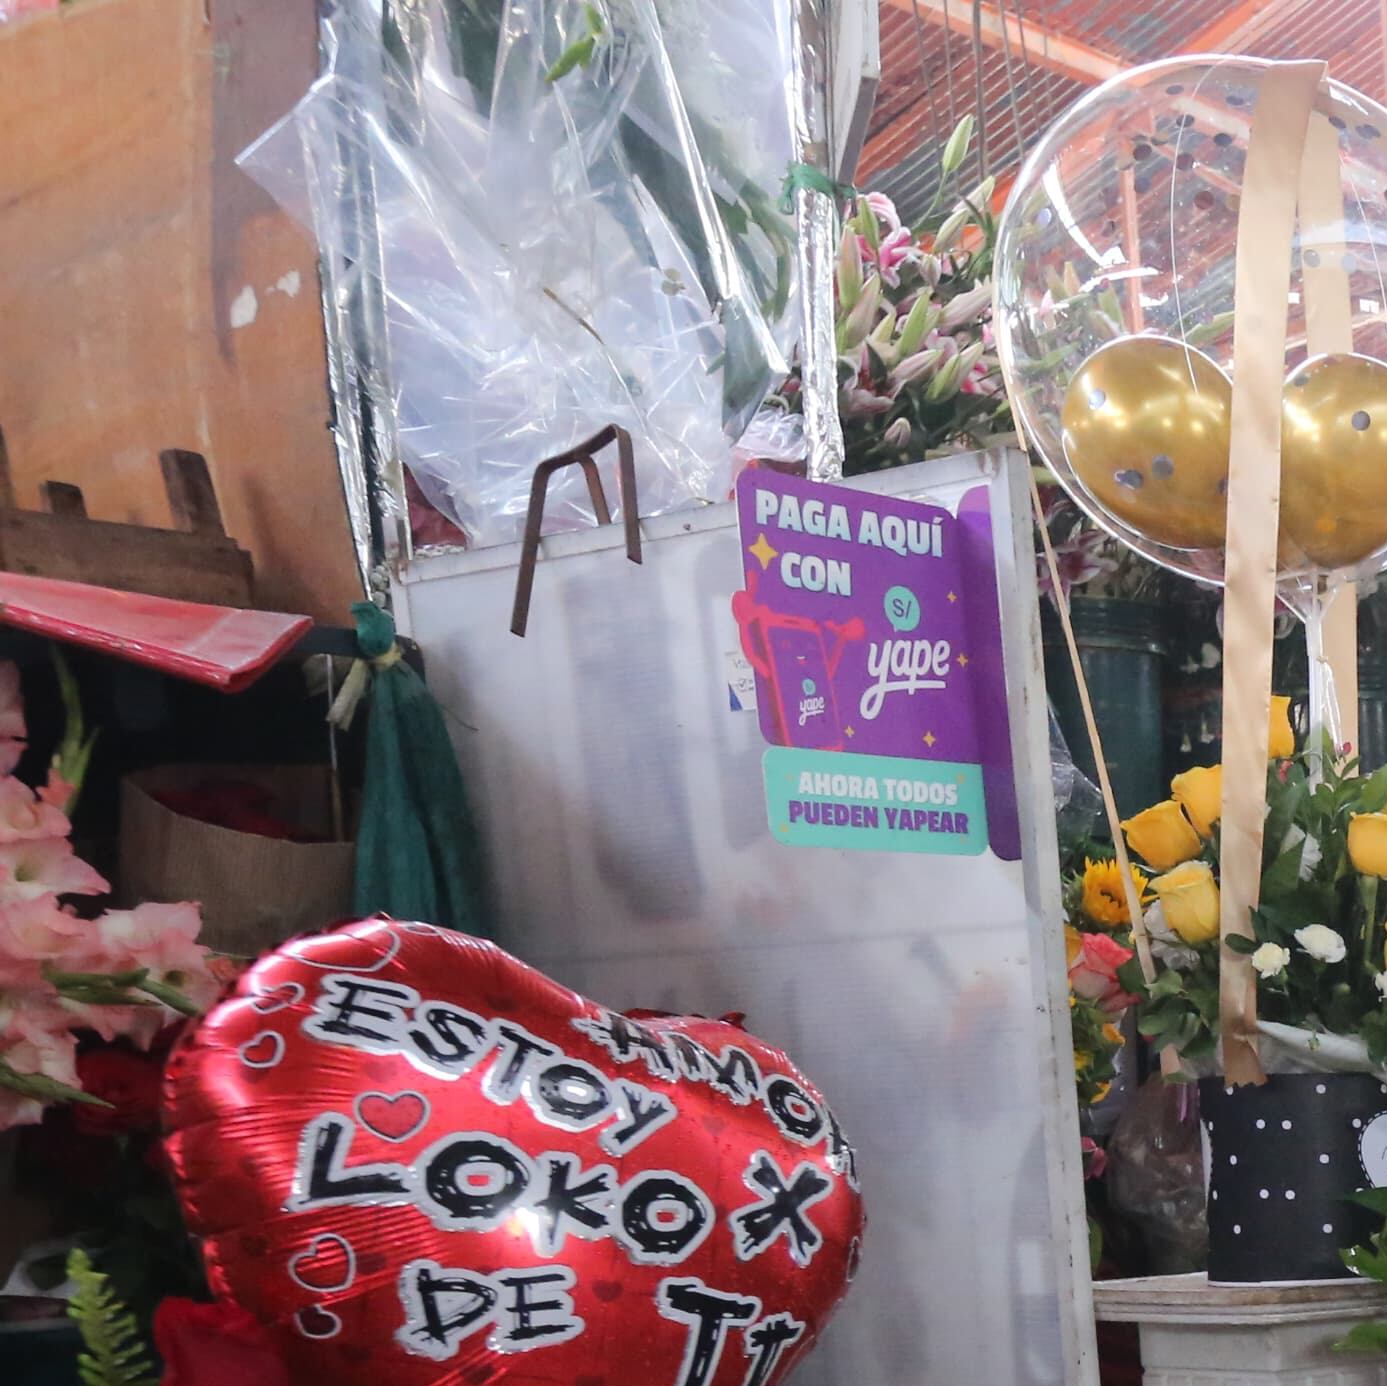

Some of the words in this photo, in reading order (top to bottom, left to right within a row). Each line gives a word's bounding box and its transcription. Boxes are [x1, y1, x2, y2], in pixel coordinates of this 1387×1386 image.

[755, 489, 851, 541] PAGA
[858, 516, 944, 558] AQUÍ
[780, 552, 852, 597] CON
[891, 598, 912, 619] S/
[860, 638, 951, 721] yape
[788, 800, 879, 830] PUEDEN
[883, 805, 969, 835] YAPEAR
[798, 770, 879, 800] AHORA
[884, 776, 958, 806] TODOS
[305, 975, 676, 1157] ESTOY
[288, 1112, 714, 1264] LOKO
[729, 1151, 833, 1265] X
[396, 1260, 585, 1358] DE
